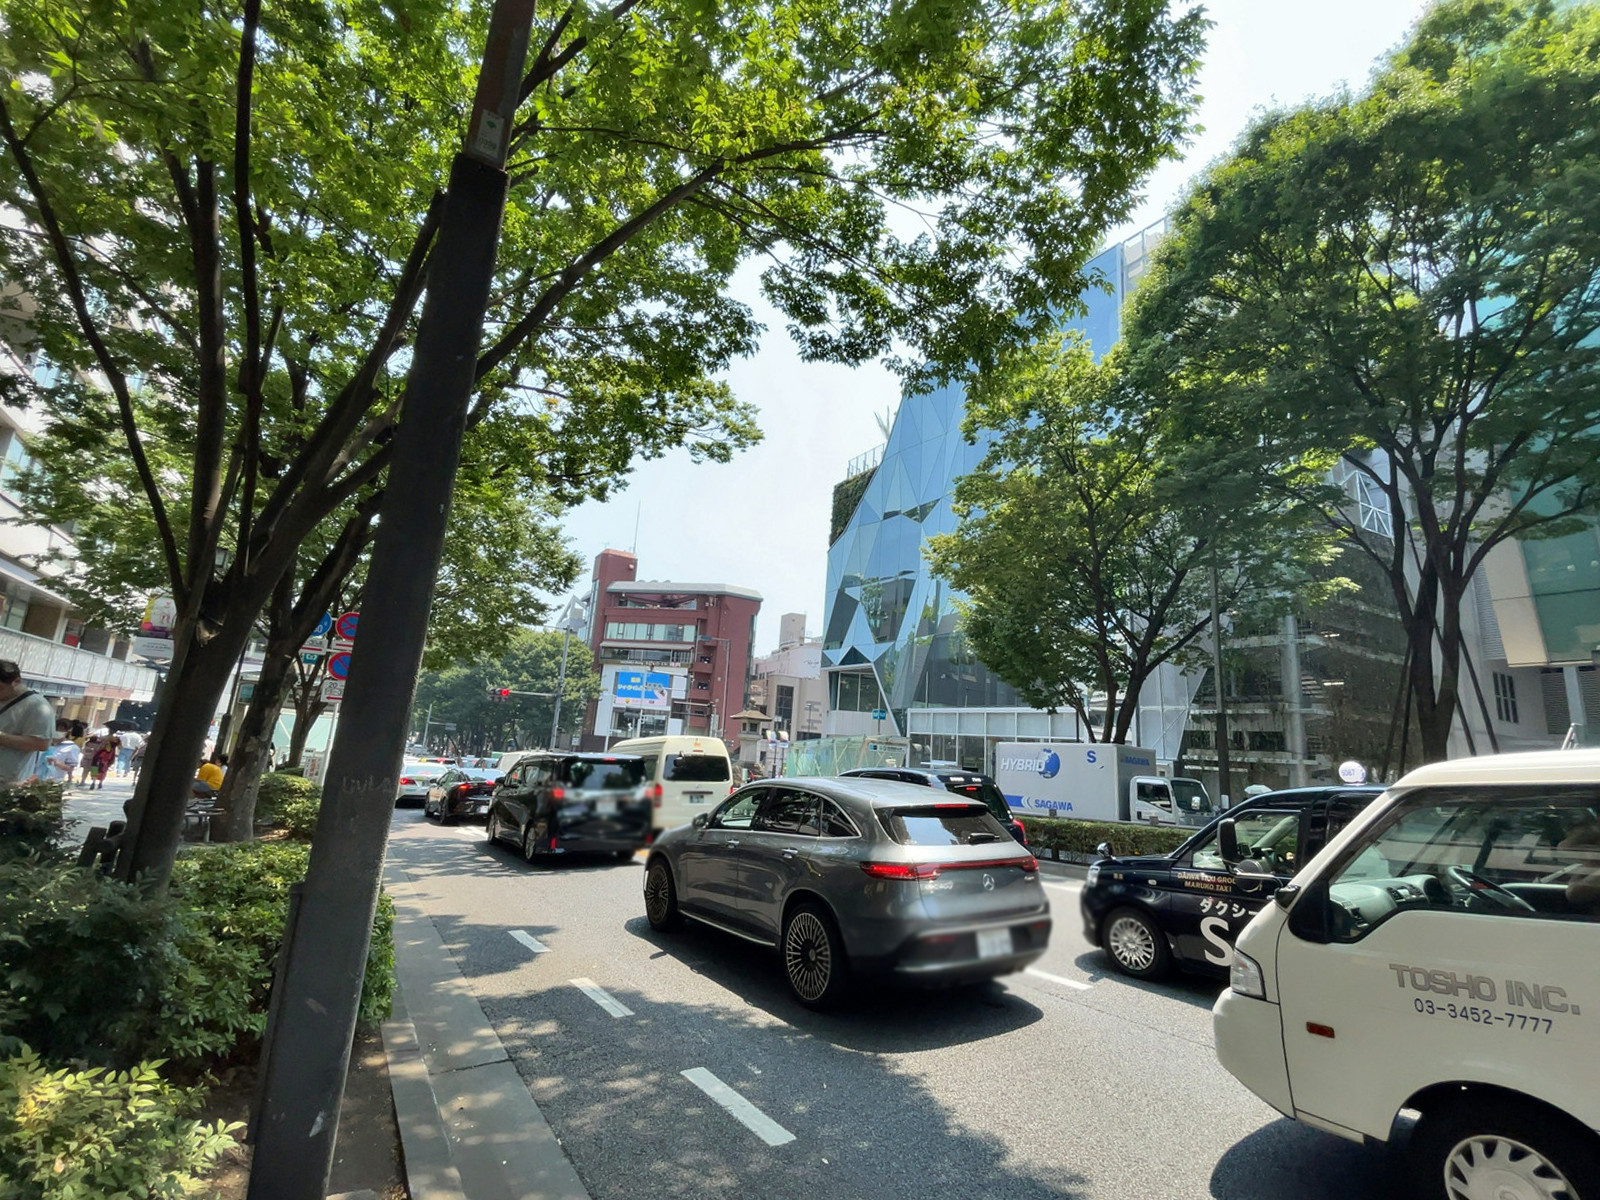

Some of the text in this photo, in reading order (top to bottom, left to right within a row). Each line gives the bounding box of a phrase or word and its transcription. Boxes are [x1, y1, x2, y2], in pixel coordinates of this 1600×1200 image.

[1086, 750, 1097, 764] S
[1000, 757, 1046, 773] HYBRID
[1034, 798, 1074, 812] SAGAWA
[1184, 881, 1232, 892] MARUKO TAXI
[1388, 963, 1582, 1016] TOSHO INC.
[1414, 998, 1553, 1034] 03-3452-7777
